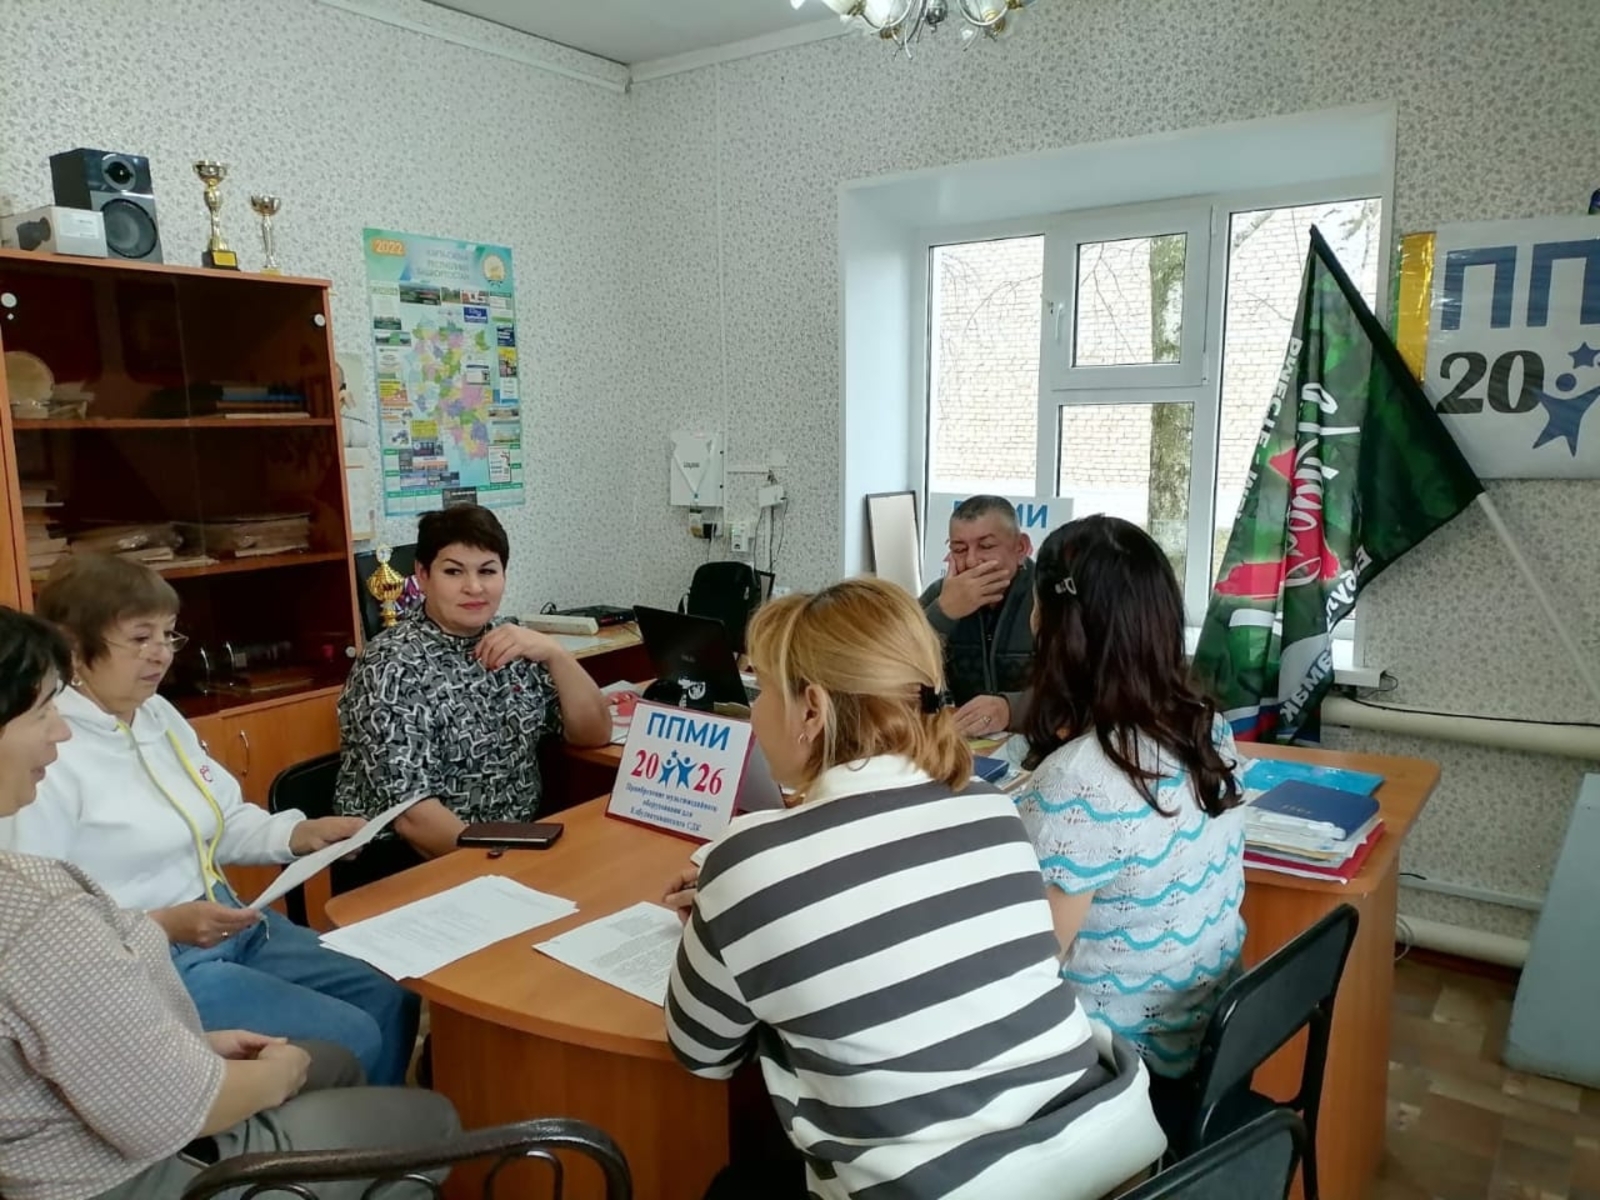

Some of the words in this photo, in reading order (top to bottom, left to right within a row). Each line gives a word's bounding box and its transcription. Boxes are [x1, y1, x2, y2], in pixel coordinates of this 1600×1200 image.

[376, 239, 404, 256] 2022
[1435, 350, 1545, 414] 20
[646, 711, 731, 751] ППМИ
[630, 749, 660, 780] 20
[692, 763, 725, 796] 26
